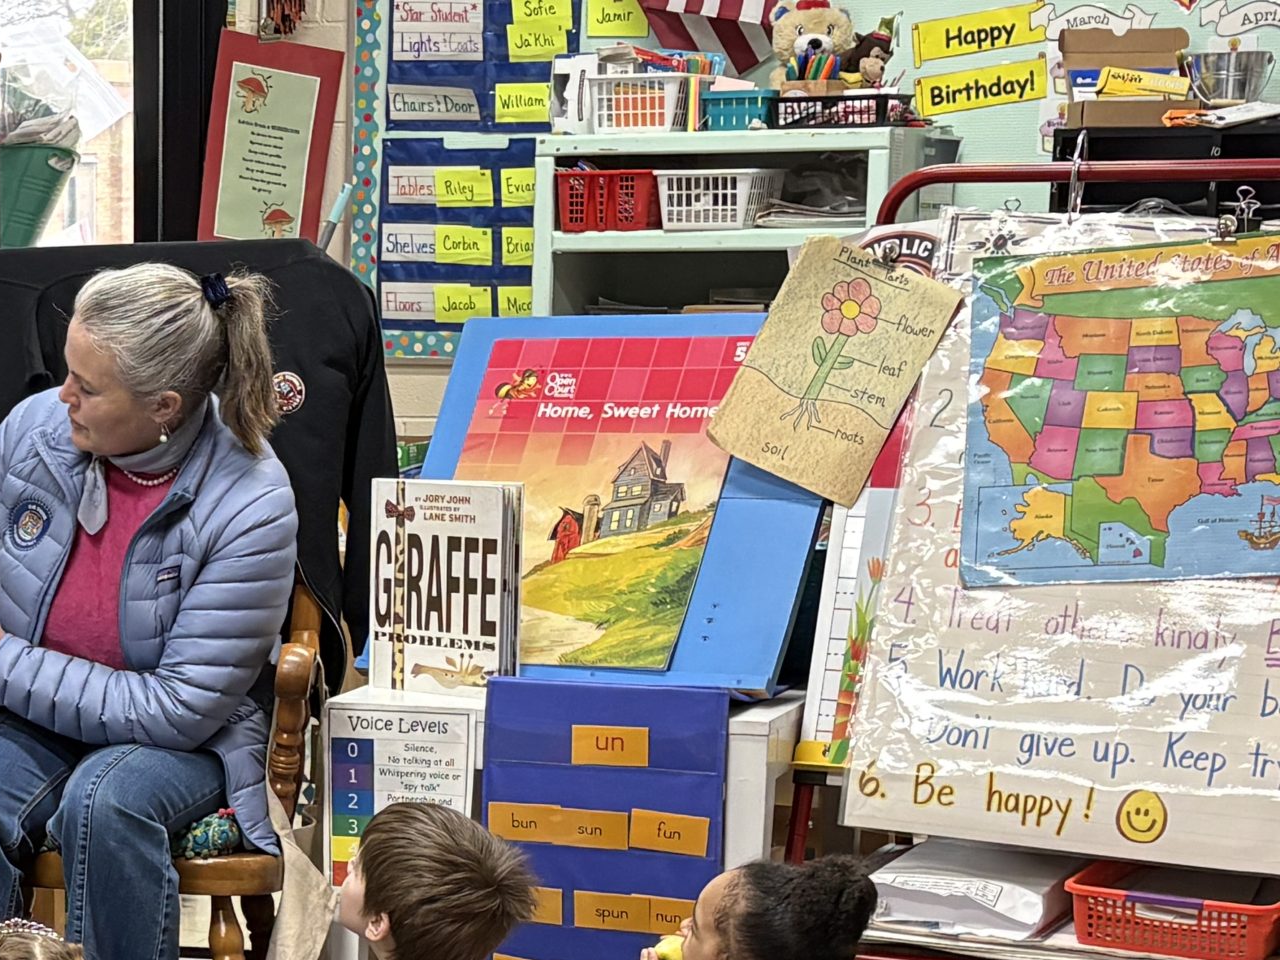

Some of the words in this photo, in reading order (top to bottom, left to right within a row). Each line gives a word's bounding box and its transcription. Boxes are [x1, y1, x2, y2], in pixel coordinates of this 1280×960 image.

[401, 2, 422, 22] Star
[431, 2, 470, 23] Student
[524, 0, 556, 17] Sofie
[596, 7, 634, 24] Jamir
[1066, 13, 1111, 30] March
[945, 23, 1016, 49] Happy
[401, 33, 440, 58] Lights
[930, 70, 1035, 106] Birthday!
[393, 94, 433, 113] Chairs
[445, 95, 476, 112] Door
[499, 95, 546, 110] William
[393, 176, 433, 196] Tables
[445, 180, 474, 201] Riley
[386, 233, 435, 254] Shelves
[443, 235, 480, 251] Corbin
[839, 246, 872, 267] Plant
[1045, 266, 1074, 284] The
[1083, 252, 1163, 280] United
[386, 292, 421, 312] Floors
[442, 296, 476, 313] Jacob
[896, 315, 935, 338] flower
[734, 346, 747, 362] 5
[879, 359, 908, 380] leaf
[850, 386, 887, 408] stem
[537, 403, 594, 420] Home,
[601, 403, 660, 418] Sweet
[666, 403, 719, 418] Home
[834, 429, 864, 446] roots
[762, 441, 789, 460] soil
[422, 495, 446, 503] JORY
[447, 496, 471, 504] JOHN
[423, 512, 446, 521] LANE
[448, 514, 476, 524] SMITH
[374, 631, 497, 652] PROBLEMS
[938, 648, 1003, 693] Work
[1180, 687, 1237, 721] your
[347, 715, 393, 732] Voice
[398, 718, 449, 734] Levels
[347, 742, 358, 758] 0
[404, 743, 438, 754] Silence,
[596, 735, 625, 752] un
[388, 756, 400, 764] No
[403, 757, 431, 767] talking
[445, 759, 455, 767] all
[1017, 732, 1076, 766] give
[1093, 739, 1136, 778] up.
[1163, 732, 1227, 787] Keep
[348, 768, 358, 783] 1
[379, 768, 427, 780] Whispering
[429, 772, 450, 780] voice
[858, 760, 886, 798] 6.
[913, 762, 954, 806] Be
[348, 793, 358, 809] 2
[348, 819, 358, 834] 3
[511, 813, 537, 830] bun
[578, 825, 603, 837] sun
[657, 822, 681, 841] fun
[595, 906, 629, 924] spun
[656, 912, 682, 924] nun
